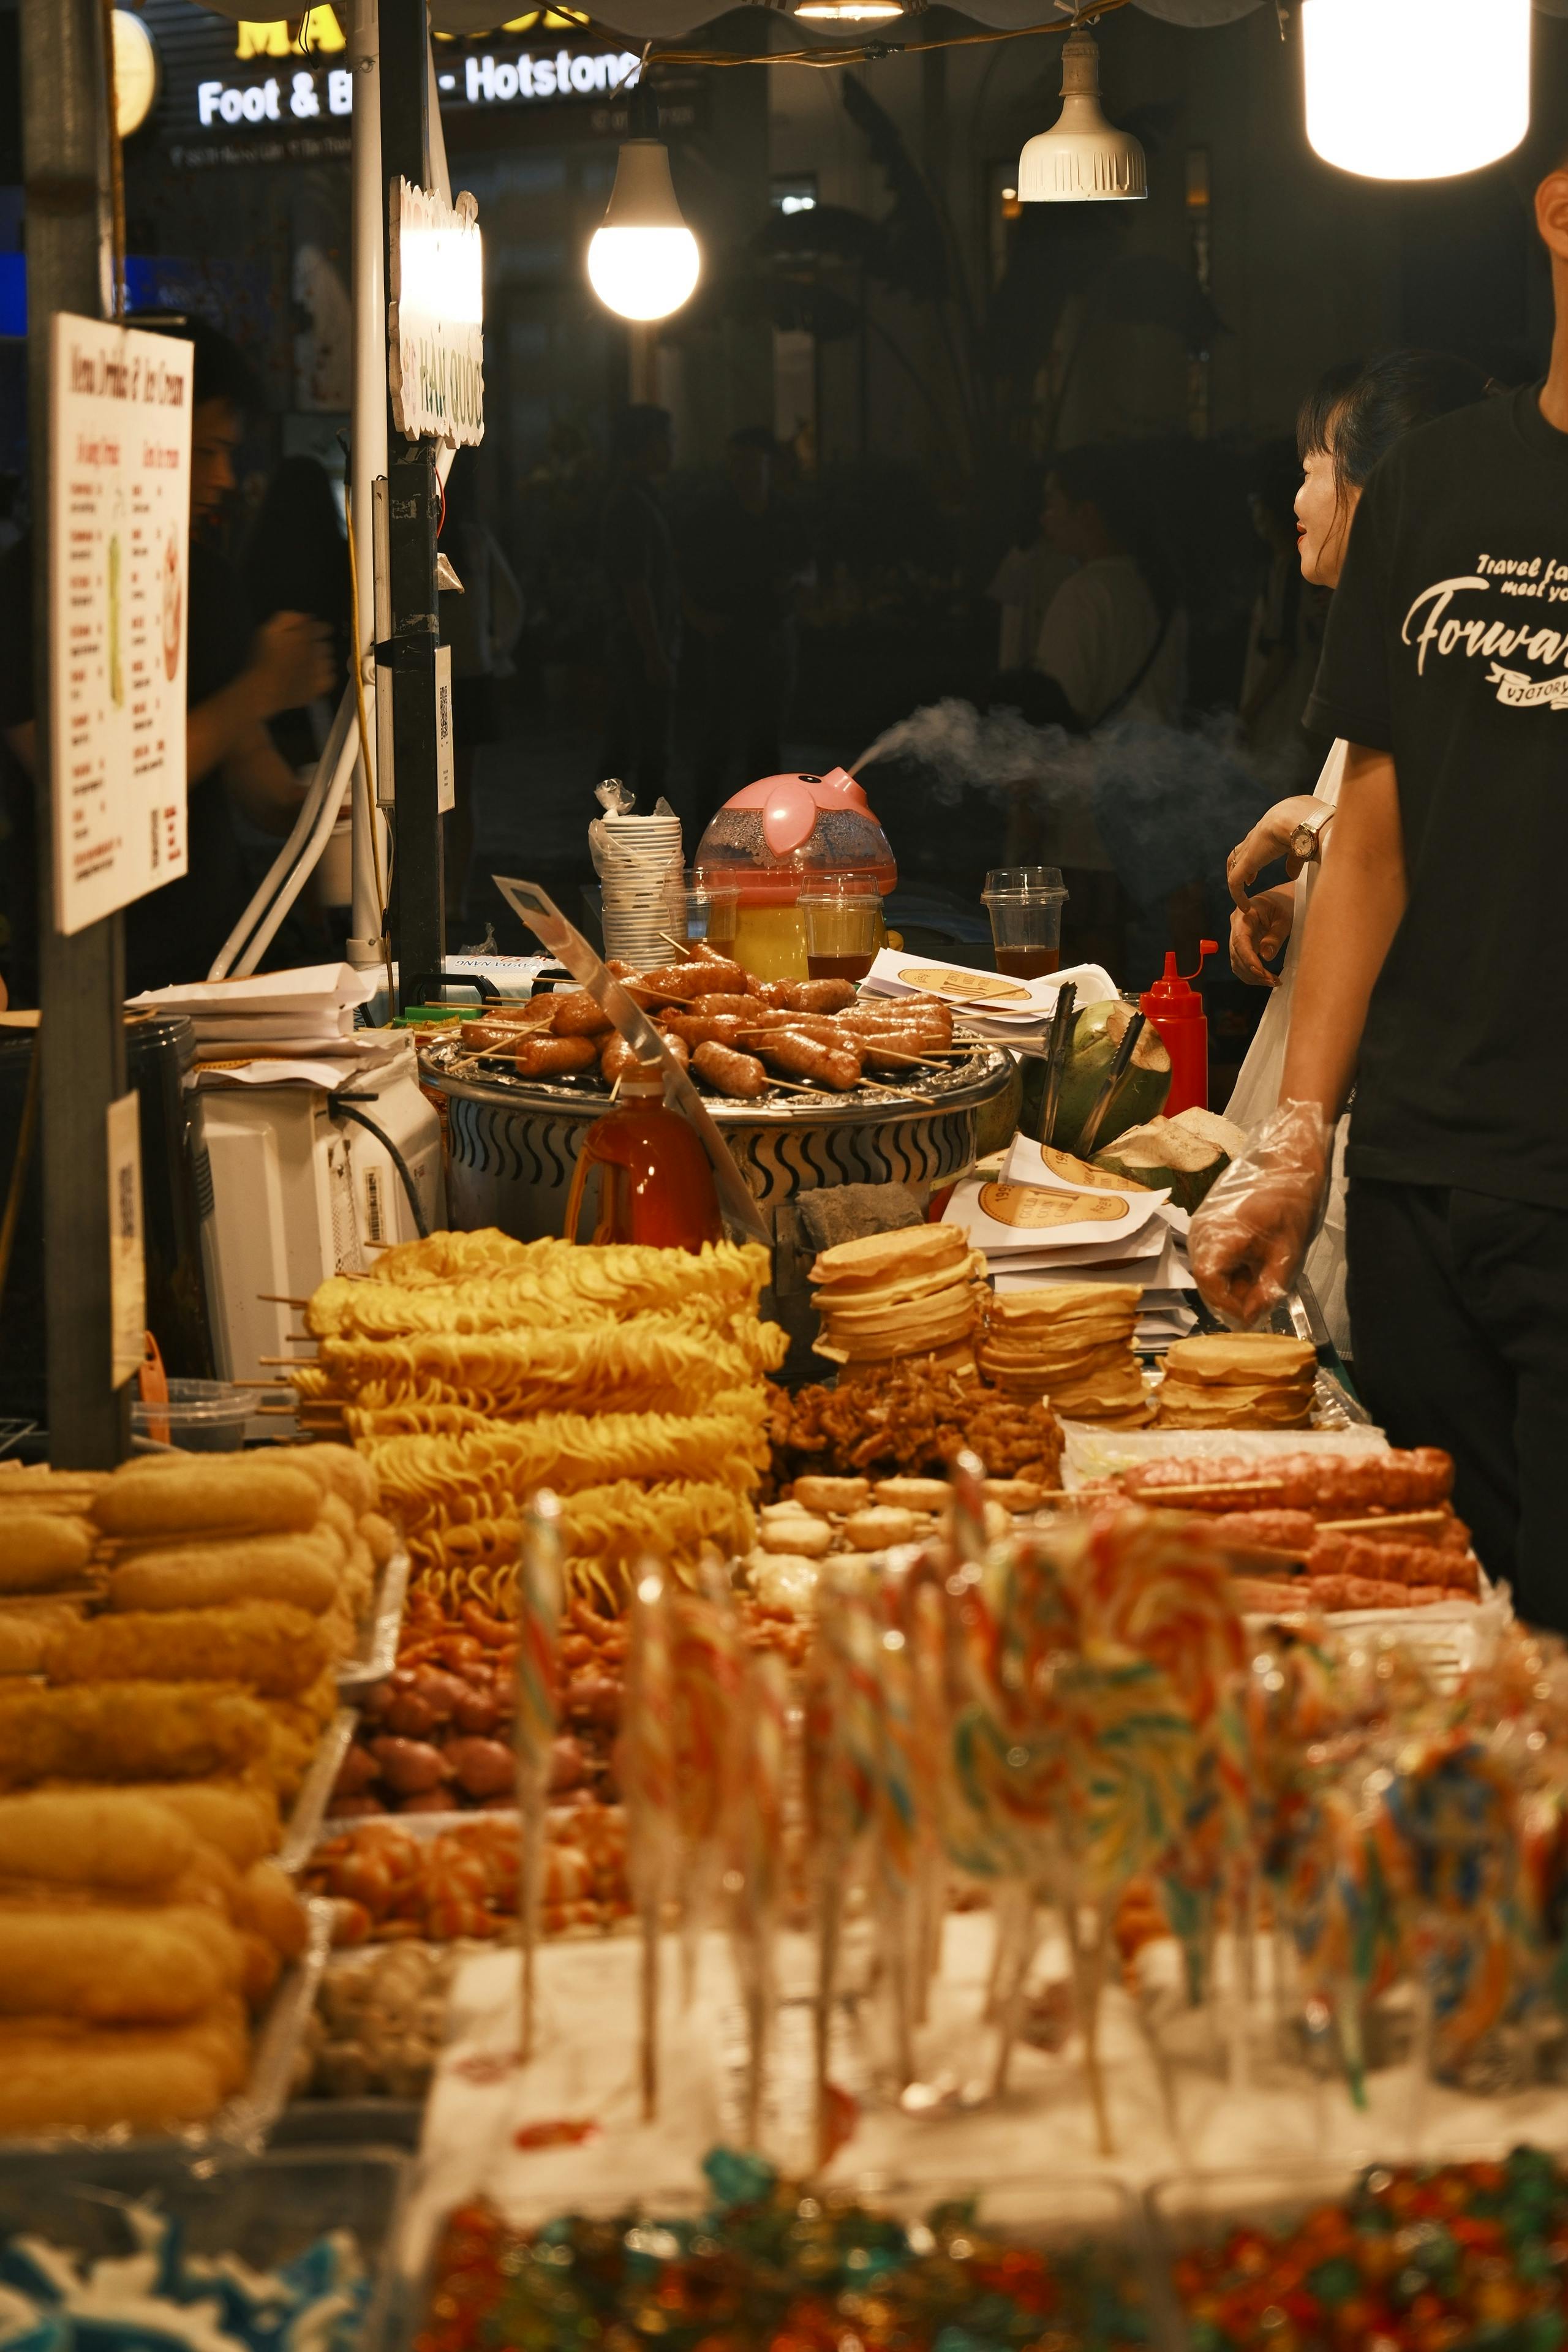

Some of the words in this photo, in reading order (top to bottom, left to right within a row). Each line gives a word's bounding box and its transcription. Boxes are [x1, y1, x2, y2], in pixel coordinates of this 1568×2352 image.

[198, 78, 281, 126] Foot
[290, 71, 320, 118] &
[1477, 554, 1541, 577] Travel
[1544, 559, 1568, 584] fa
[1501, 581, 1545, 597] meet
[1548, 586, 1568, 603] yo
[1019, 1197, 1038, 1219] GOLD
[1037, 1200, 1054, 1218] COIN
